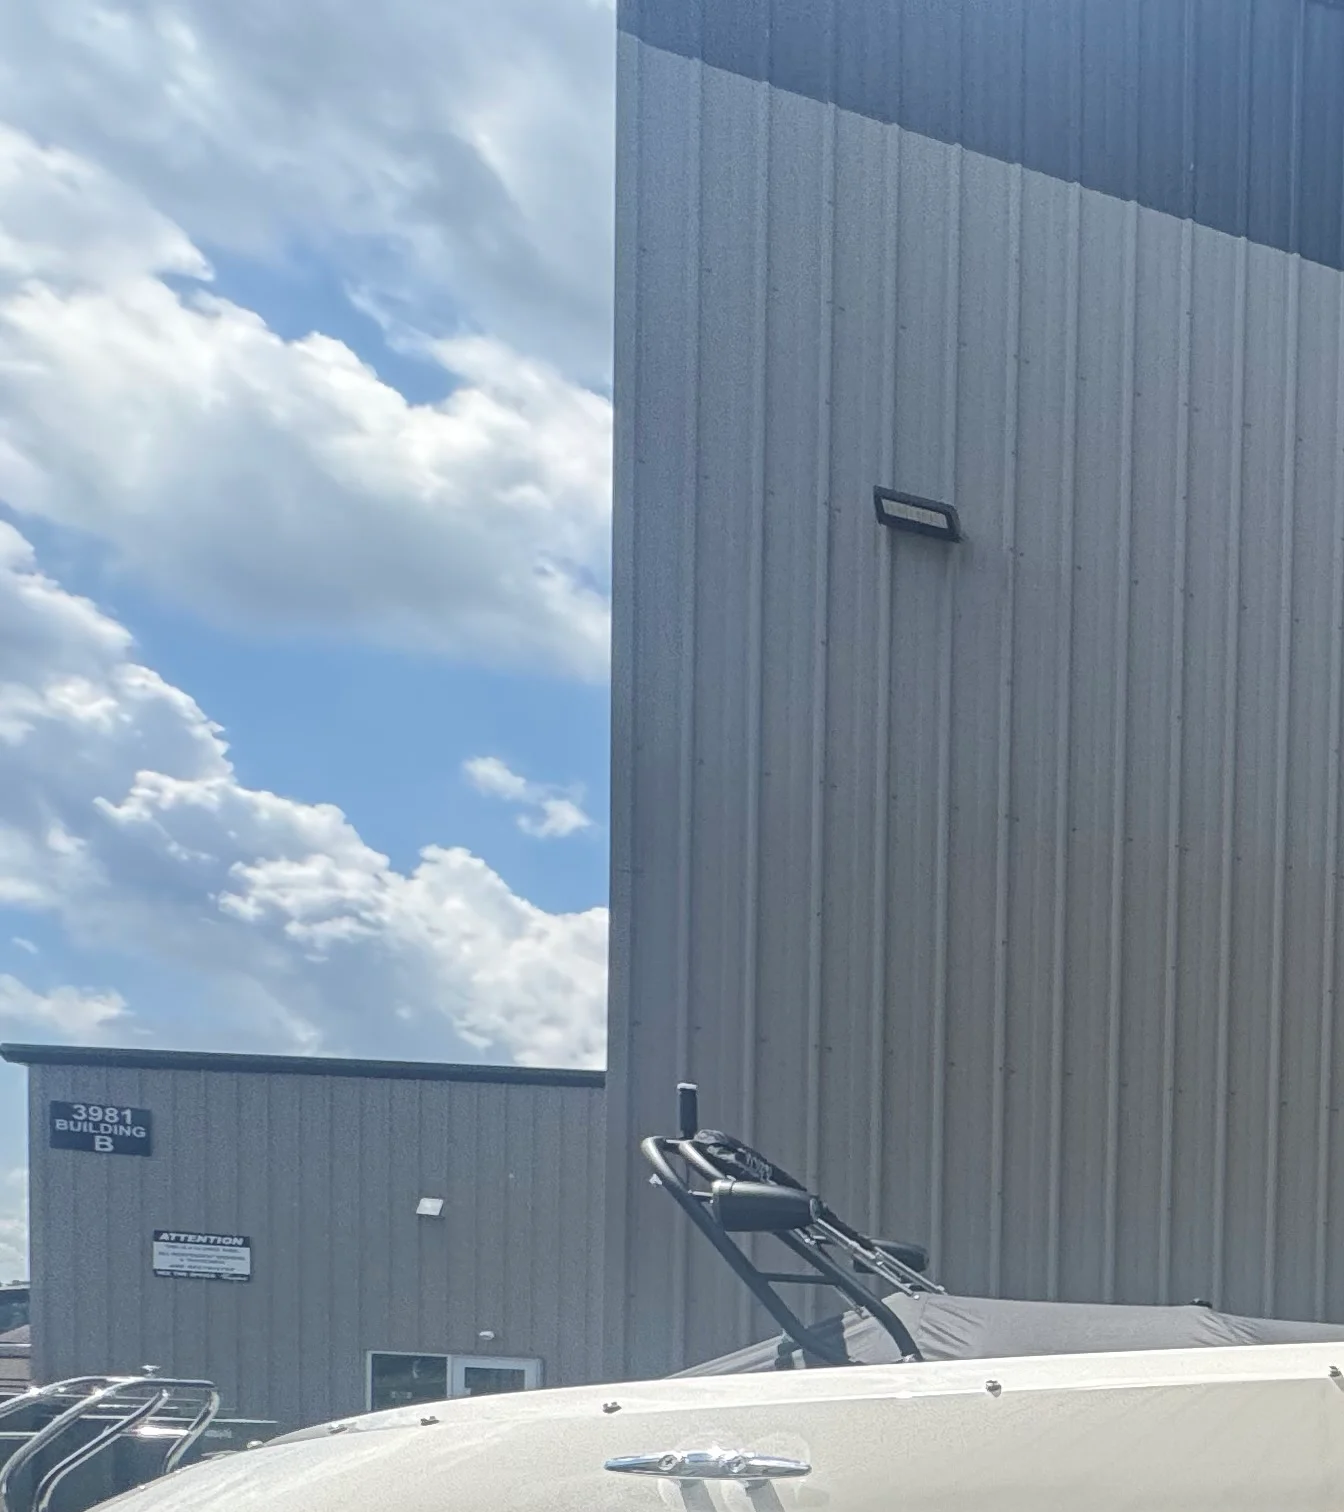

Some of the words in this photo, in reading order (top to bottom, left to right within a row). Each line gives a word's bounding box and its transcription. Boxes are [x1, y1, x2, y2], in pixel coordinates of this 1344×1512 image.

[72, 1104, 132, 1125] 3981
[55, 1119, 147, 1138] BUILDING
[94, 1135, 114, 1152] B
[160, 1232, 244, 1246] ATTENTION
